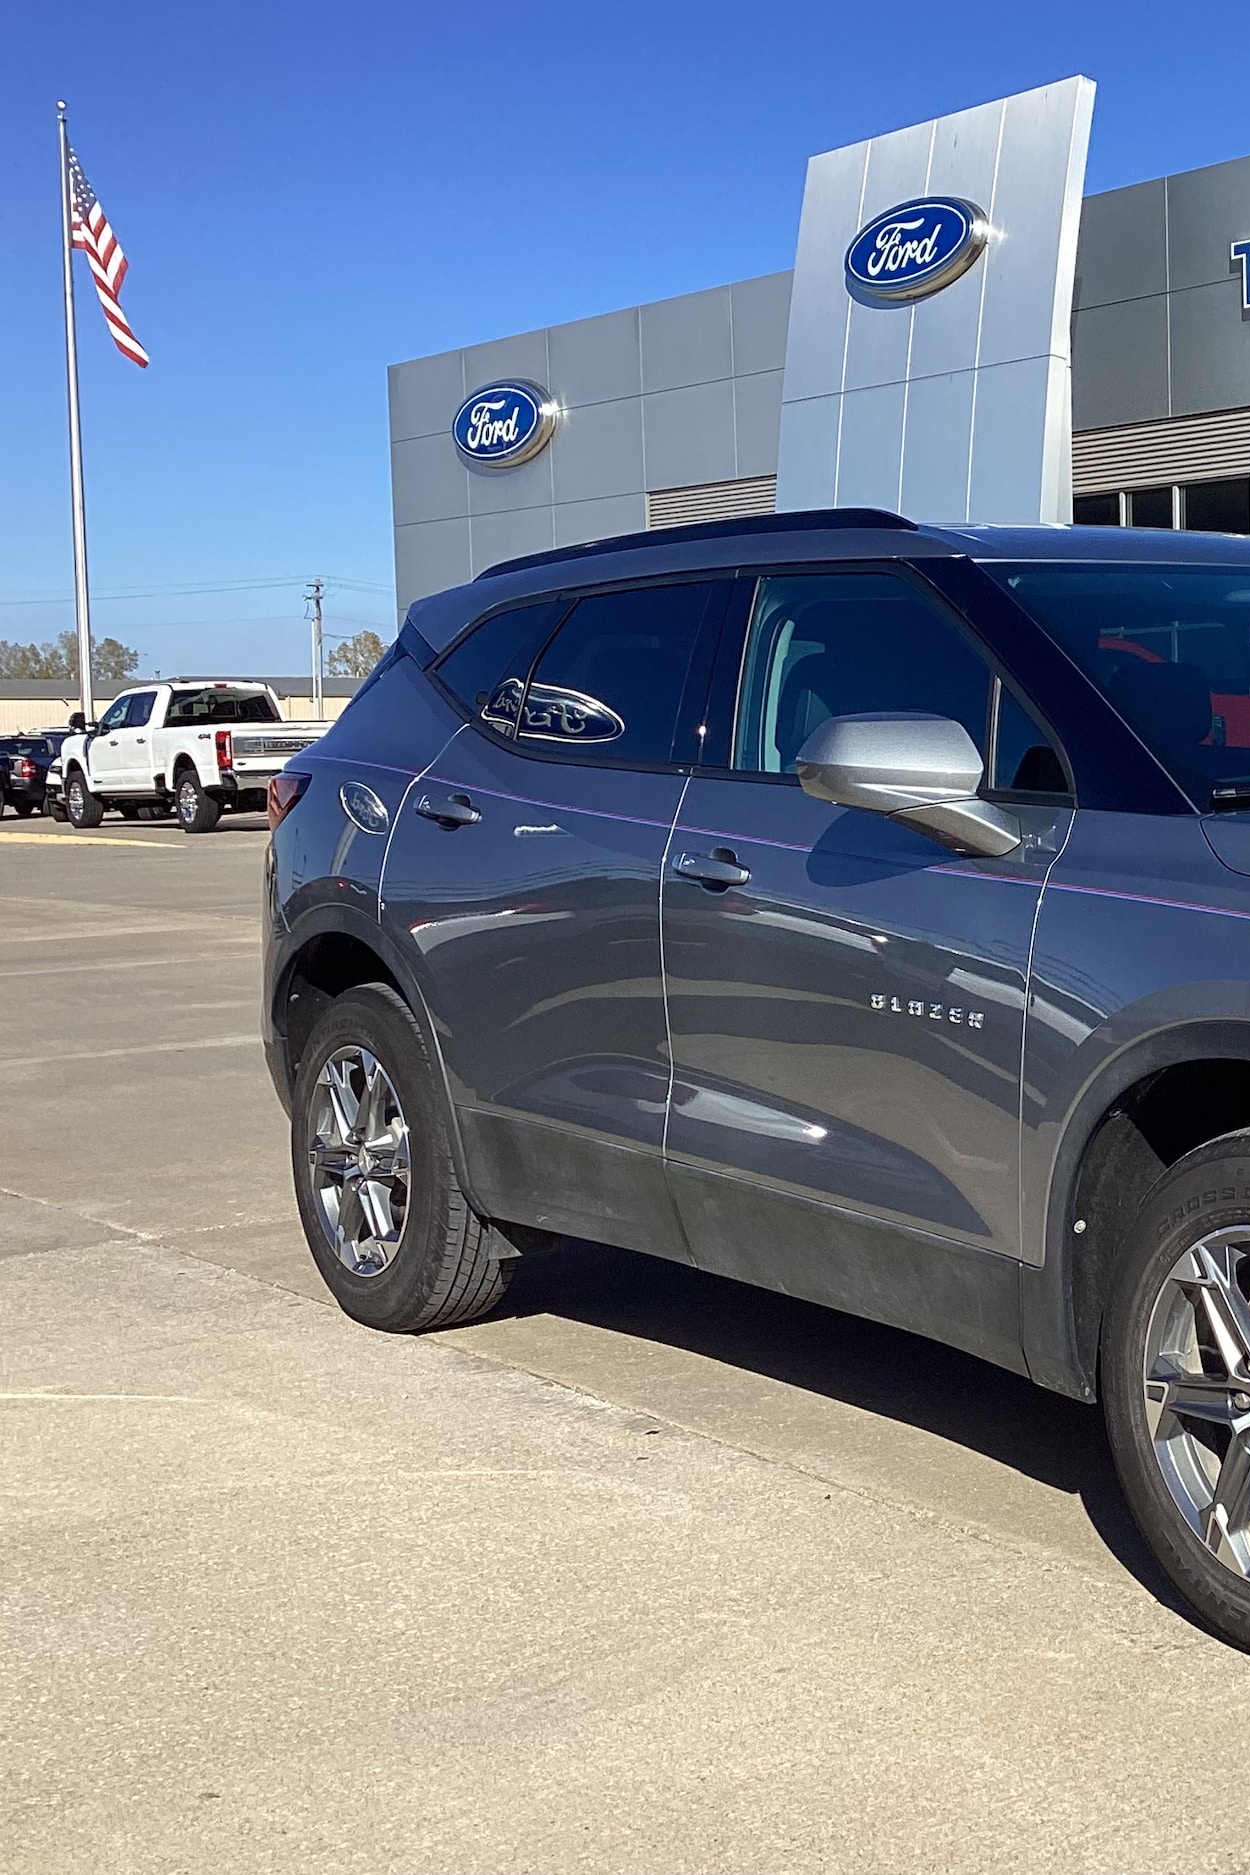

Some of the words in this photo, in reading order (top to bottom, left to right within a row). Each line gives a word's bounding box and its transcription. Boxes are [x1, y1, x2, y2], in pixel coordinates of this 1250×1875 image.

[867, 217, 943, 277] Ford
[467, 399, 520, 449] Ford
[869, 993, 985, 1029] BLAZER
